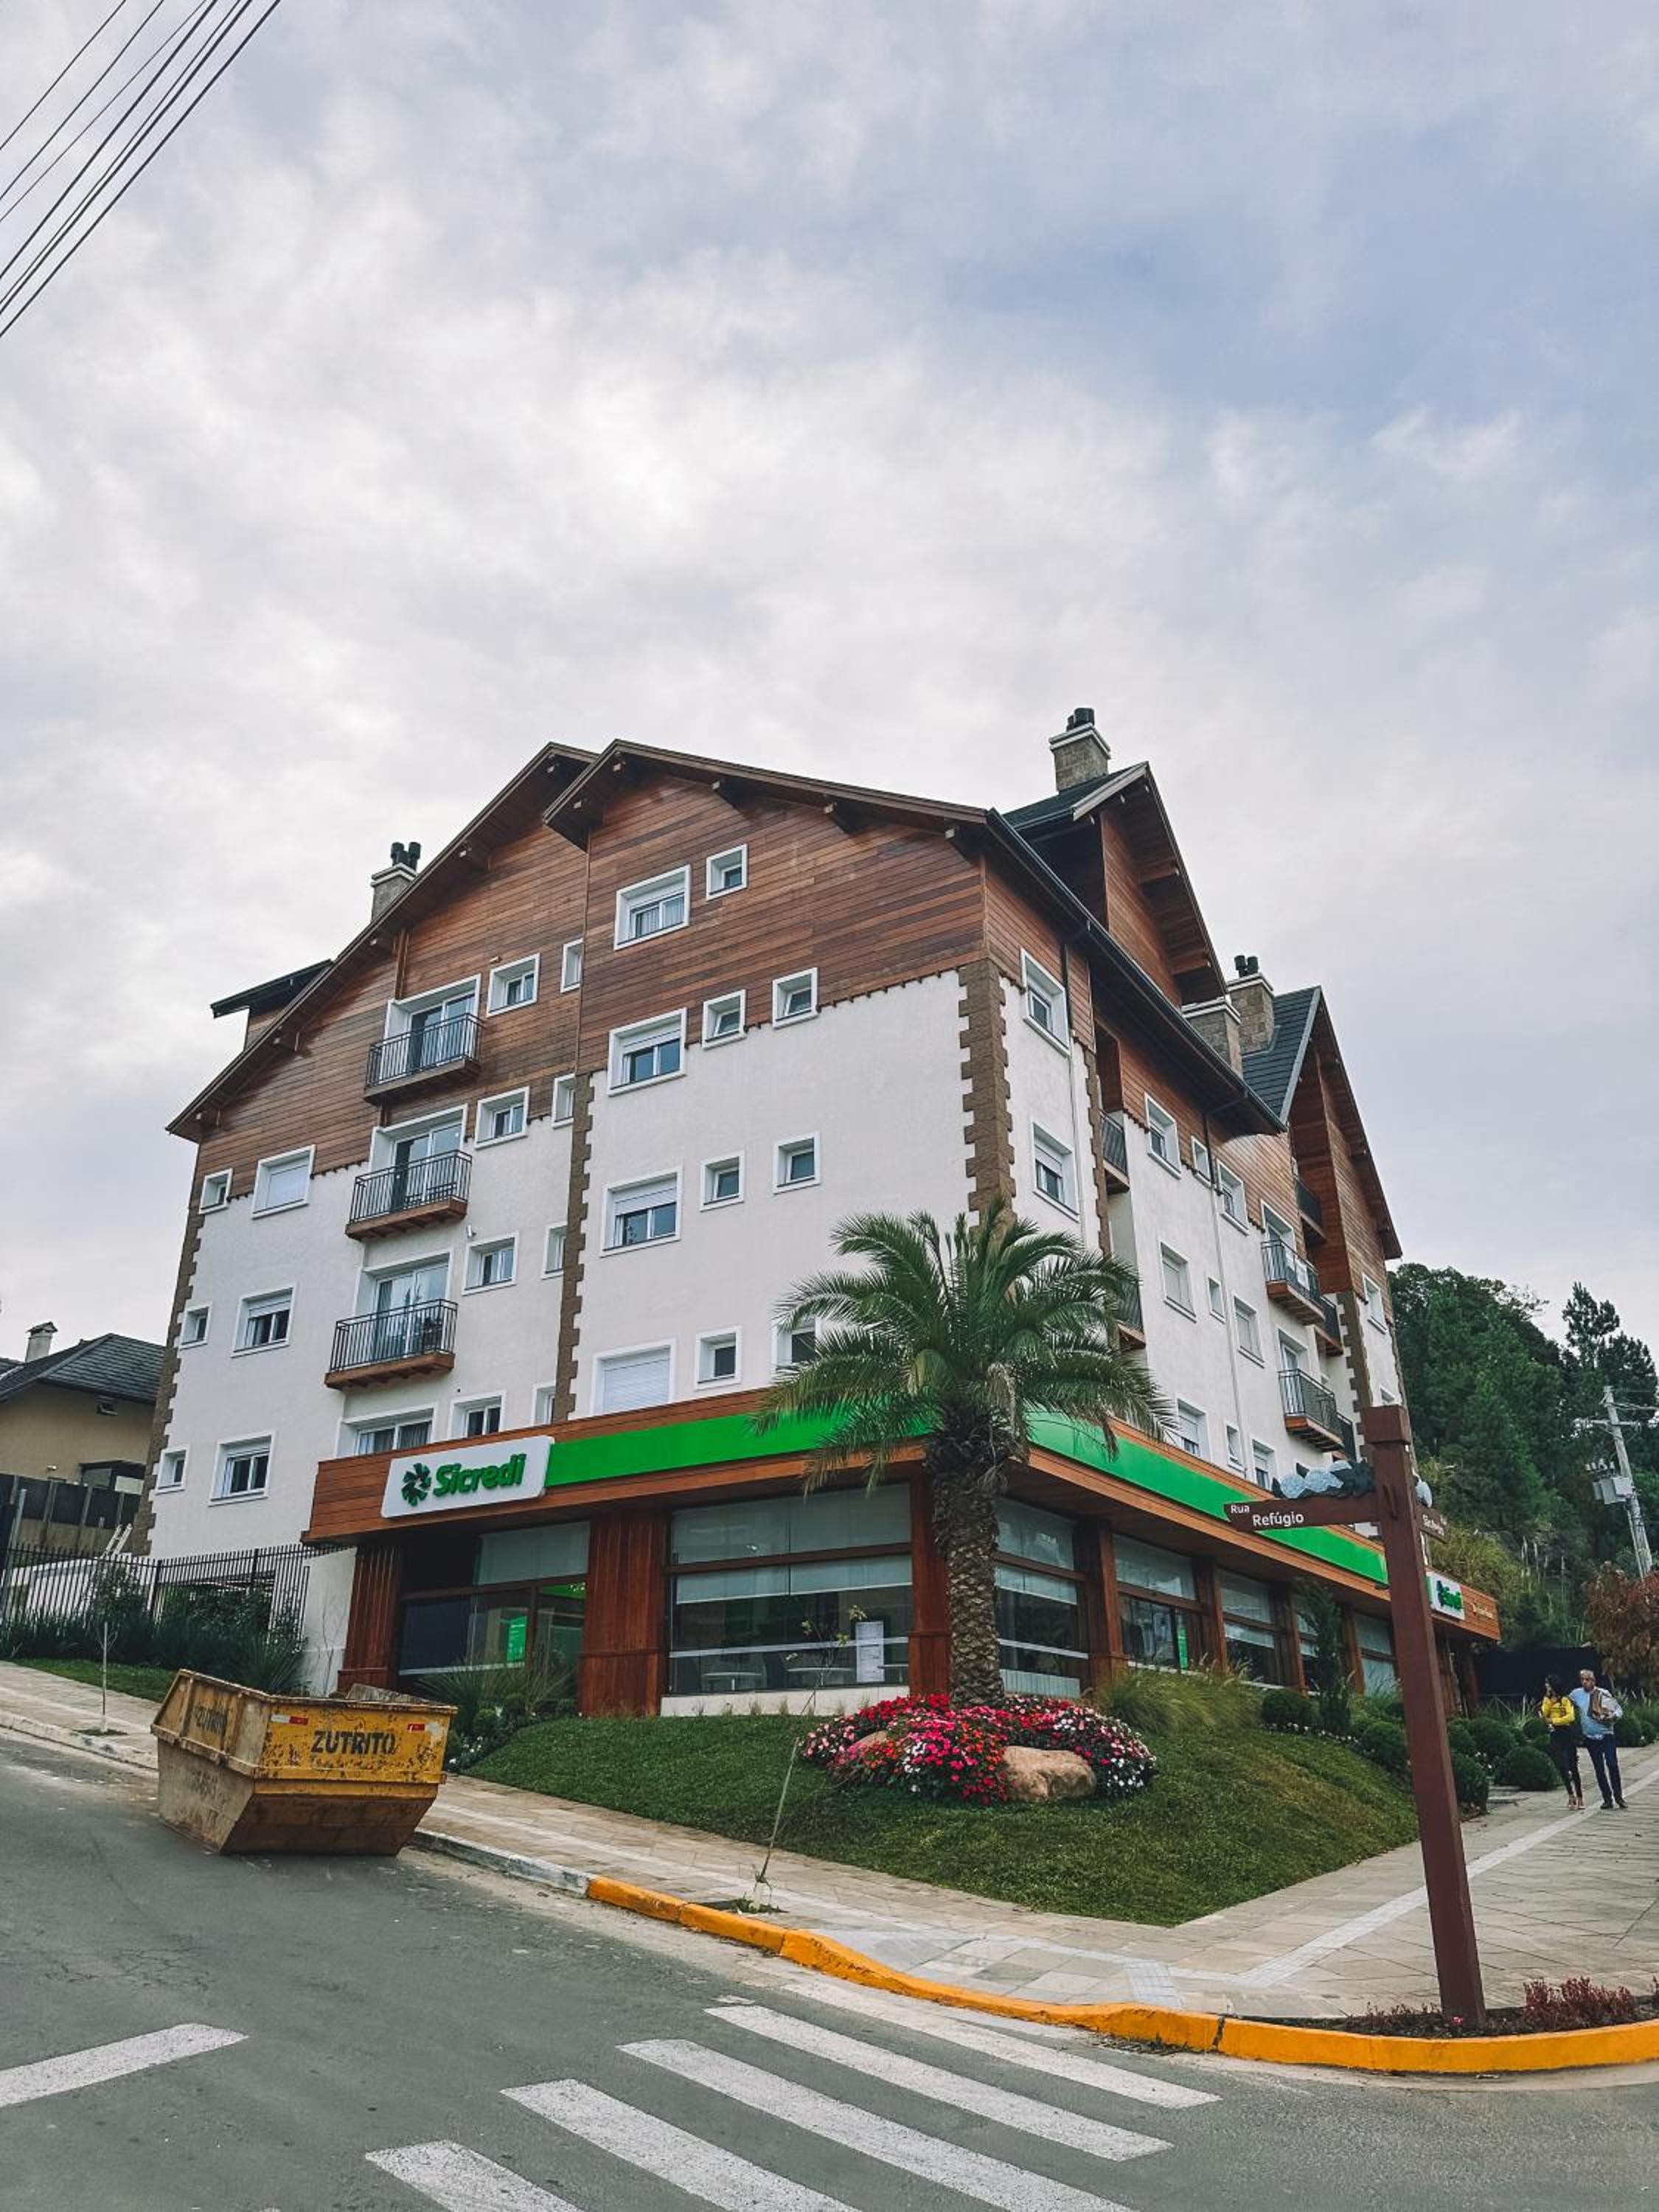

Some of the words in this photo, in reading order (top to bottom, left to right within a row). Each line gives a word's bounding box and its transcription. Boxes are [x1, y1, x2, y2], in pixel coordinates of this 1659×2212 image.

[433, 1453, 526, 1497] Sicredi
[1231, 1505, 1250, 1514] Rua
[1253, 1512, 1304, 1527] Refúgio
[310, 1731, 397, 1755] ZUTRITO
